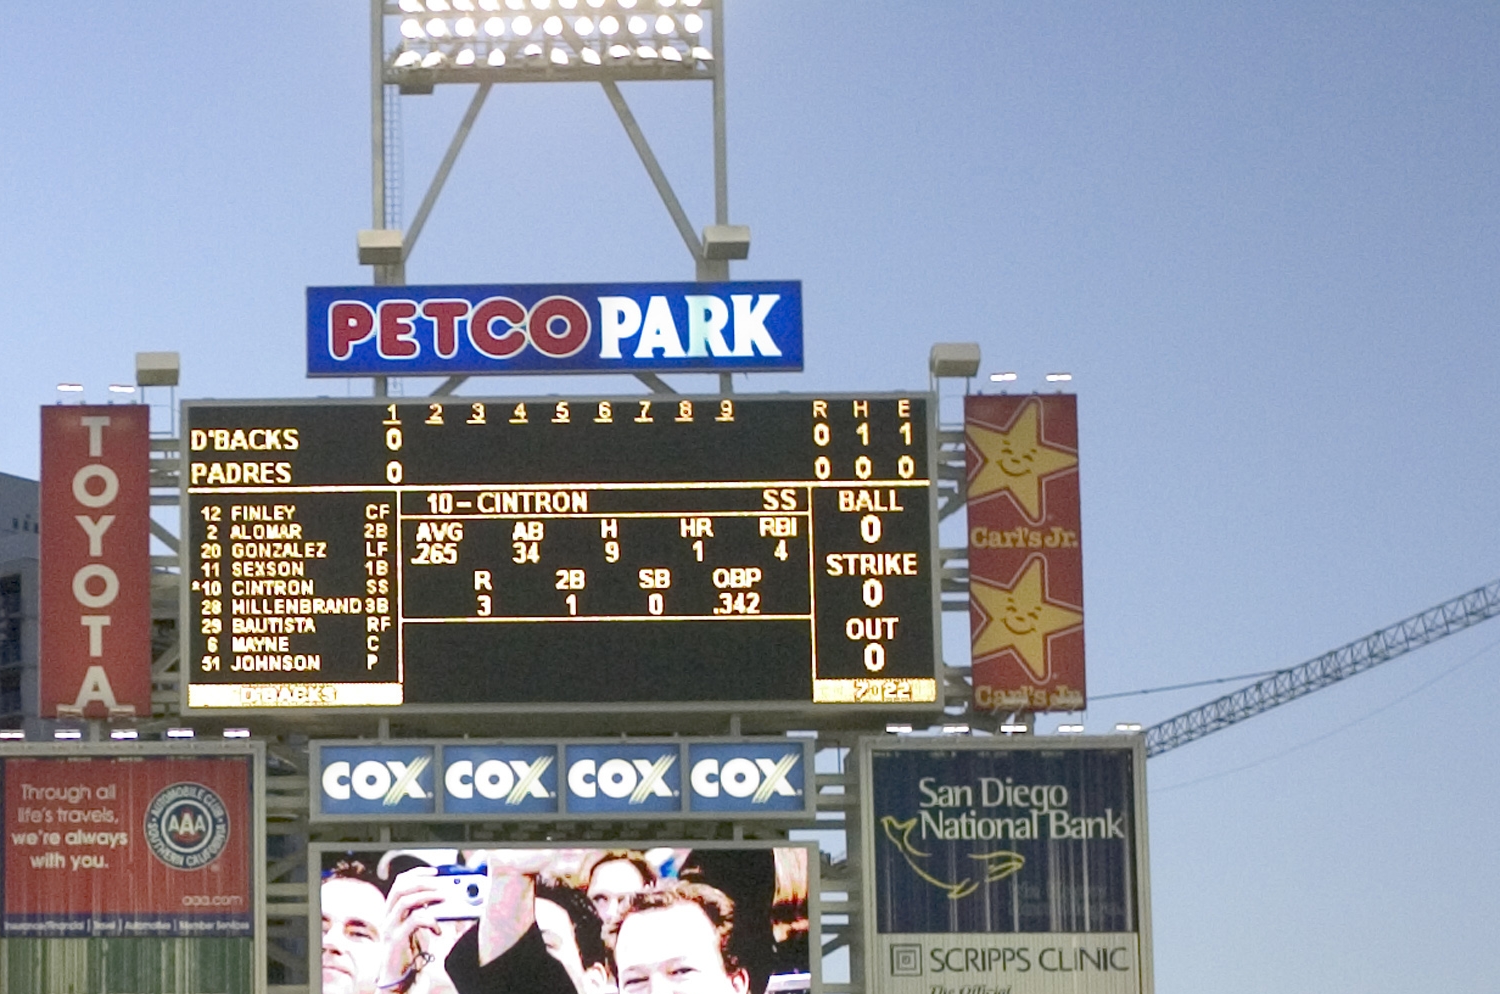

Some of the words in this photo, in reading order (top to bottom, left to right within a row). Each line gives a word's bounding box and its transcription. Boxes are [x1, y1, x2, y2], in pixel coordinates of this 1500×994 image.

[327, 295, 591, 360] PETCO
[598, 294, 782, 358] PARK
[191, 429, 298, 450] D'BACKS
[386, 428, 402, 450] 0
[814, 423, 829, 446] 0
[856, 423, 868, 445] 1
[900, 422, 911, 445] 1
[191, 463, 291, 484] PADRES
[387, 461, 402, 483] 0
[815, 457, 830, 480] 0
[856, 456, 871, 480] 0
[899, 455, 914, 481] 0
[763, 488, 798, 512] SS
[839, 490, 903, 511] BALL
[201, 506, 221, 521] 12
[231, 505, 295, 521] FINLEY
[366, 504, 389, 520] CF
[207, 525, 217, 540] 2
[230, 524, 302, 539] ALOMAR
[364, 523, 387, 538] 2B
[416, 522, 463, 542] AVG
[513, 521, 543, 541] AB
[601, 519, 617, 538] H
[681, 517, 714, 538] HR
[760, 517, 797, 537] RBI
[861, 514, 881, 543] 0
[970, 527, 1042, 549] Carl's
[1045, 527, 1078, 549] Jr.
[201, 543, 221, 559] 20
[232, 542, 326, 558] GONZALEZ
[366, 542, 387, 557] LF
[411, 543, 457, 564] .265
[513, 542, 540, 563] 34
[605, 541, 619, 562] 9
[693, 541, 703, 561] 1
[774, 541, 788, 560] 4
[71, 416, 120, 708] TOYOTA
[201, 562, 219, 577] 11
[232, 561, 303, 577] SEXSON
[365, 561, 388, 576] 1B
[827, 553, 917, 576] STRIKE
[232, 580, 313, 596] CINTRON
[367, 579, 388, 594] SS
[475, 571, 492, 590] R
[556, 570, 585, 589] 2B
[639, 569, 670, 588] SB
[713, 568, 761, 588] OBP
[477, 595, 491, 616] 3
[566, 594, 576, 615] 1
[649, 593, 663, 615] 0
[713, 592, 760, 614] .342
[863, 579, 883, 607] 0
[202, 600, 222, 615] 28
[232, 598, 362, 615] HILLENBRAND
[365, 598, 388, 613] 3B
[202, 618, 222, 634] 29
[233, 617, 315, 633] BAUTISTA
[367, 617, 391, 632] RF
[846, 617, 899, 639] OUT
[208, 637, 218, 653] 6
[233, 636, 289, 652] MAYNE
[367, 636, 379, 651] C
[202, 656, 219, 671] 51
[231, 655, 320, 671] JOHNSON
[368, 655, 377, 670] P
[864, 643, 884, 671] 0
[322, 756, 432, 805] COX
[444, 756, 554, 805] COX
[567, 755, 678, 804] COX
[690, 754, 801, 803] COX
[21, 783, 91, 803] Through
[96, 783, 116, 800] all
[919, 777, 972, 808] San
[980, 777, 1069, 815] Diego
[18, 806, 53, 823] life's
[168, 812, 206, 836] AAA
[918, 809, 1039, 840] National
[1047, 808, 1125, 840] Bank
[11, 829, 61, 845] we're
[65, 829, 128, 849] always
[29, 852, 66, 869] with
[70, 855, 109, 871] you.
[182, 896, 243, 907] aaa.com
[930, 947, 1031, 973] SCRIPPS
[1038, 947, 1130, 972] CLINIC
